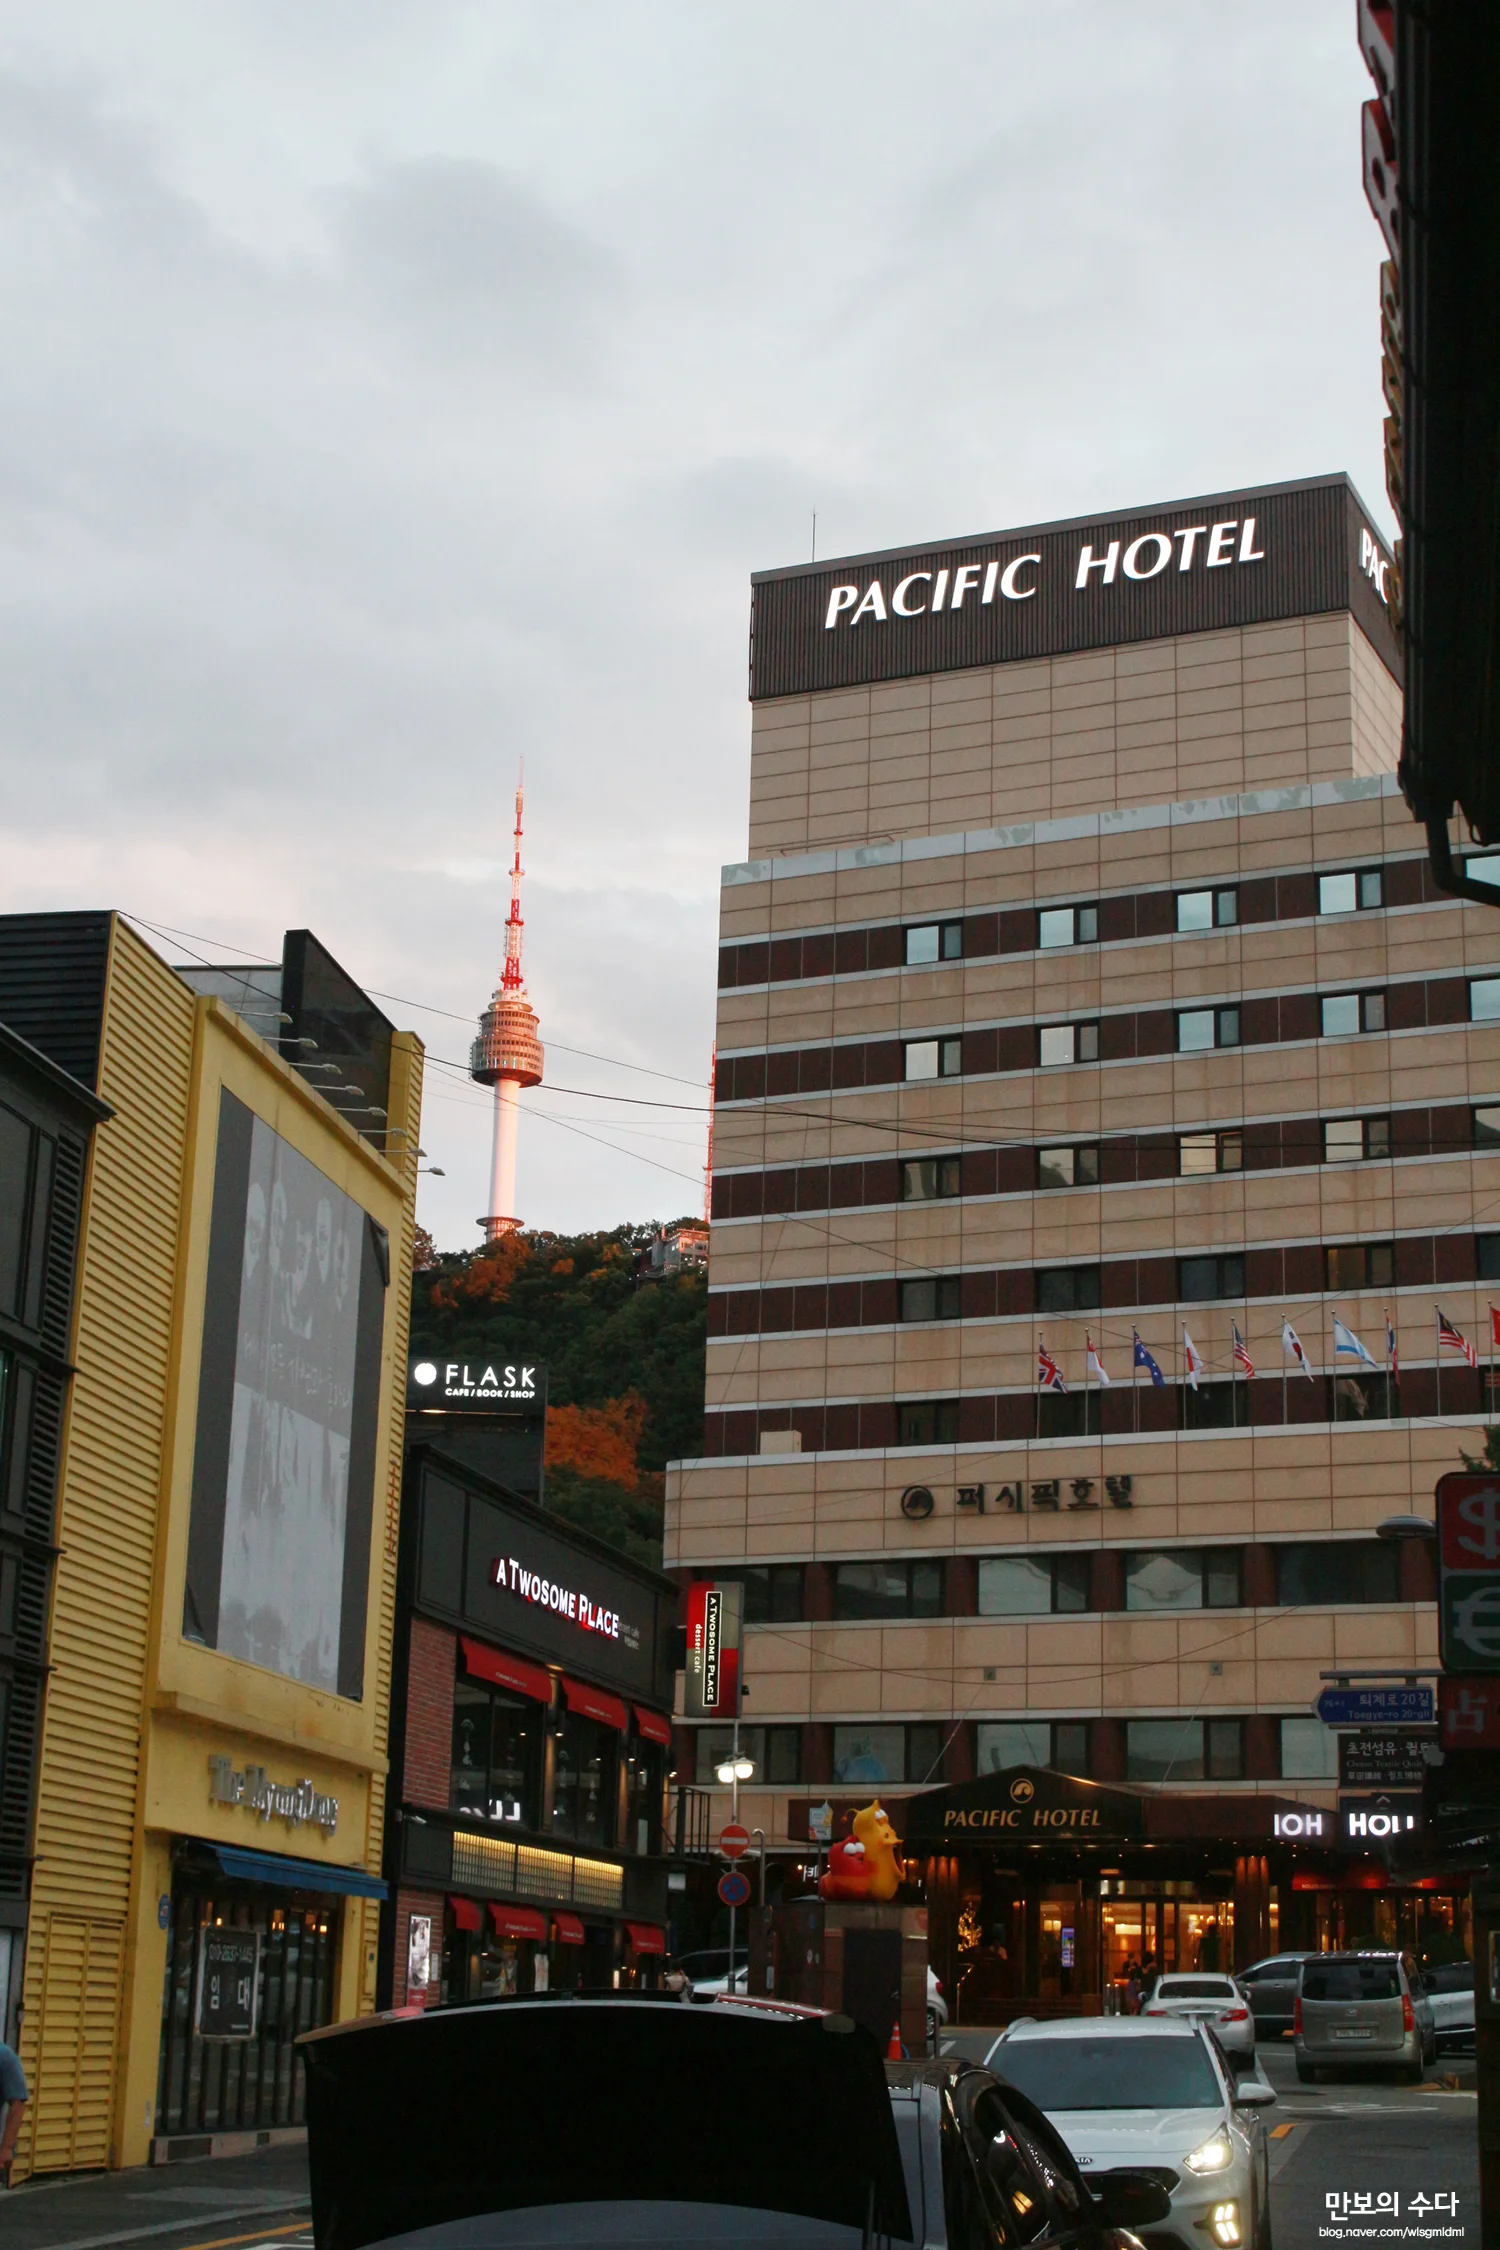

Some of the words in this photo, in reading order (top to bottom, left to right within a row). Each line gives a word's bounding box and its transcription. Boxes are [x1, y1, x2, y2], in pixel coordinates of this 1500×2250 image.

[824, 554, 1042, 630] PACIFIC
[1075, 518, 1265, 590] HOTEL
[445, 1363, 536, 1389] FLASK
[578, 1593, 619, 1638] PLACE
[708, 1605, 718, 1662] TWOSOME
[694, 1655, 702, 1674] cafe
[706, 1665, 716, 1702] PLACE
[208, 1754, 244, 1806] The
[944, 1809, 1021, 1827] PACIFIC
[1033, 1809, 1100, 1827] HOTEL
